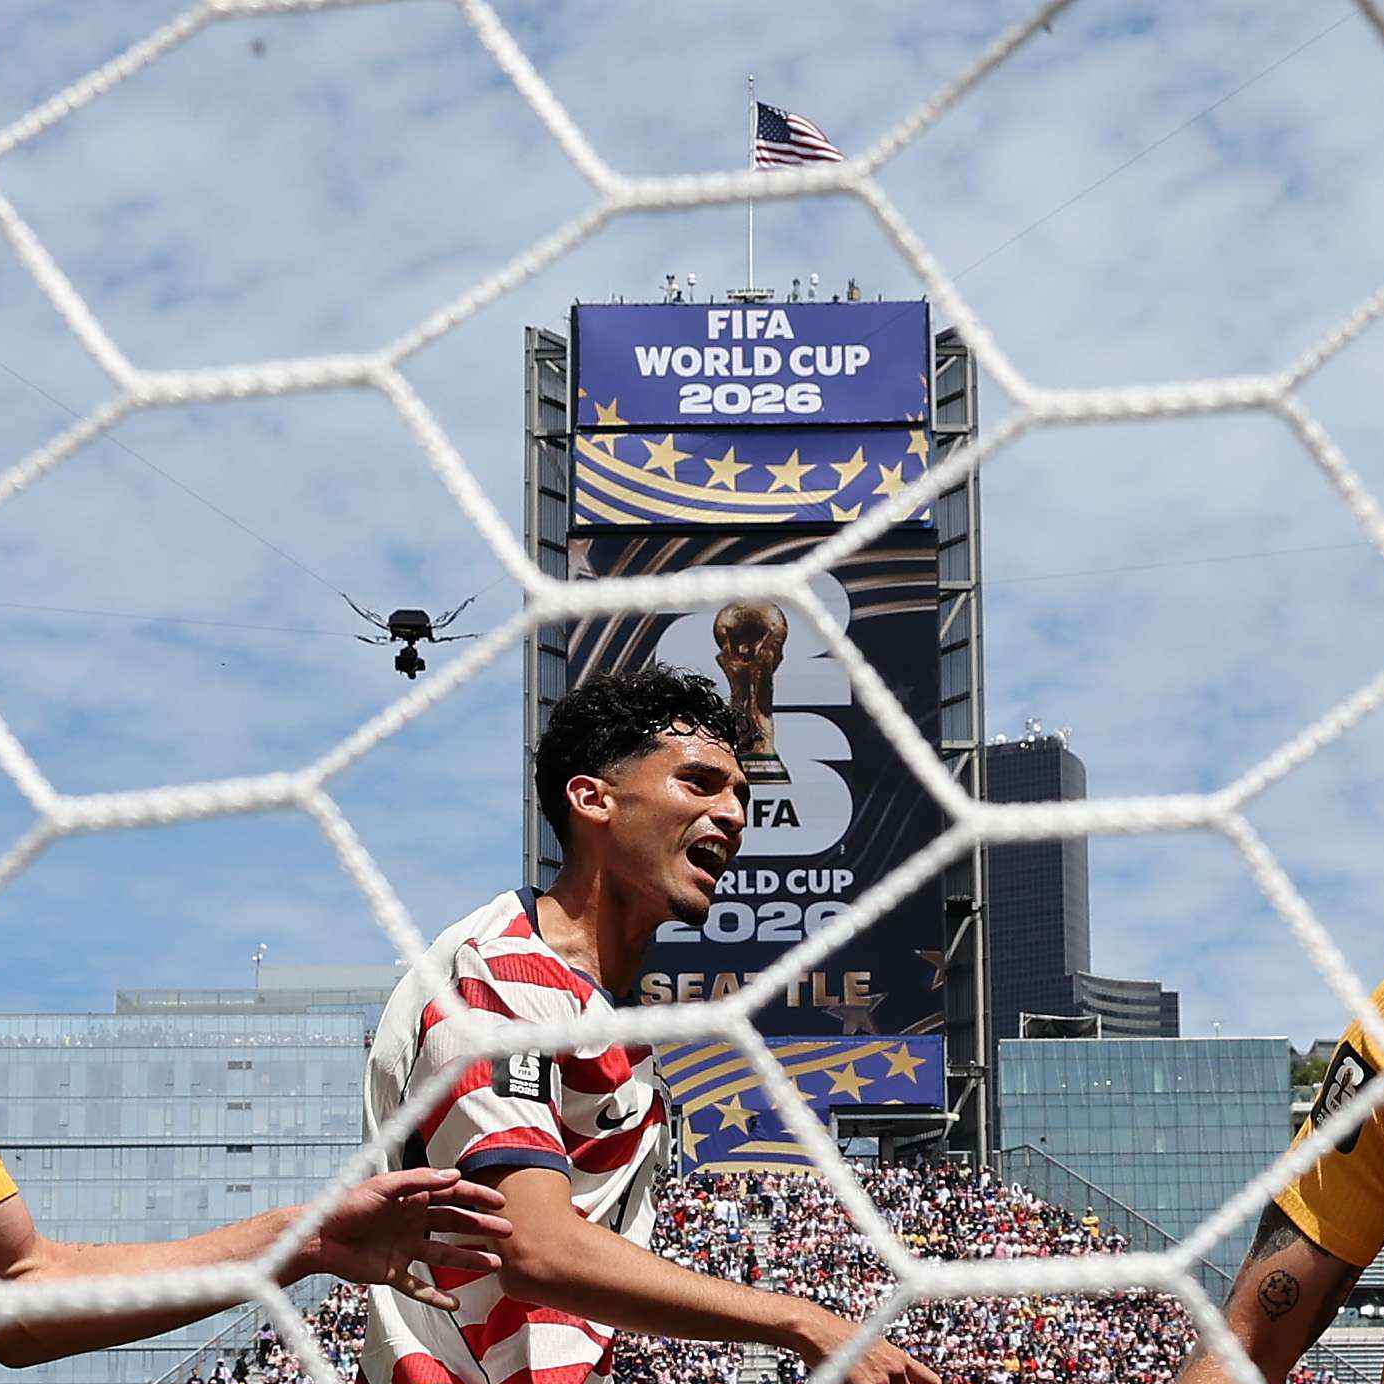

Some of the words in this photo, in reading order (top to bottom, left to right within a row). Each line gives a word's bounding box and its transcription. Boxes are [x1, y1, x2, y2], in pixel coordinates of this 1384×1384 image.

[707, 309, 795, 340] FIFA
[634, 345, 782, 377] WORLD
[789, 345, 871, 376] CUP
[678, 383, 823, 415] 2026
[752, 799, 801, 828] FA
[715, 870, 780, 895] RLD
[785, 869, 854, 895] CUP
[509, 1084, 540, 1097] 2026
